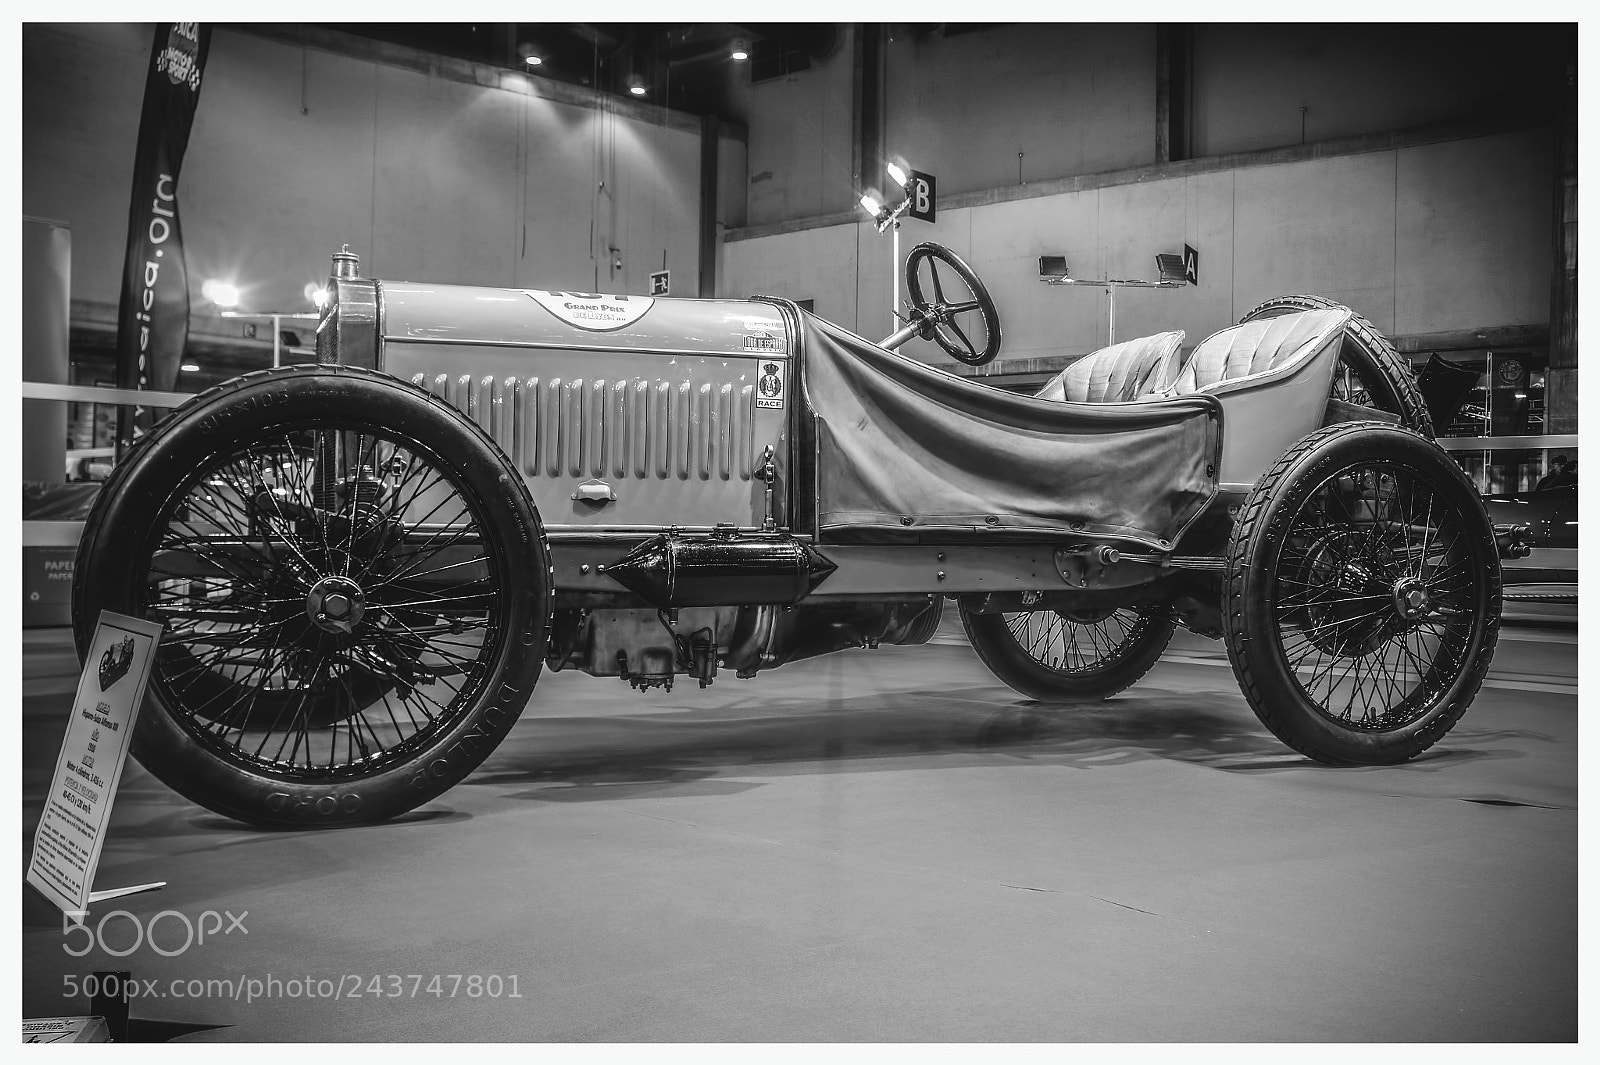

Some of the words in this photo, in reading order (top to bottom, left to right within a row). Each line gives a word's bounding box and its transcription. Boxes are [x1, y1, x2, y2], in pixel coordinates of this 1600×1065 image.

[166, 47, 193, 70] MOTOR
[167, 61, 189, 82] SPORT
[916, 178, 930, 213] B
[1185, 252, 1196, 280] A
[563, 302, 599, 311] GRAND
[600, 304, 626, 313] PRIX
[757, 400, 782, 408] RACE
